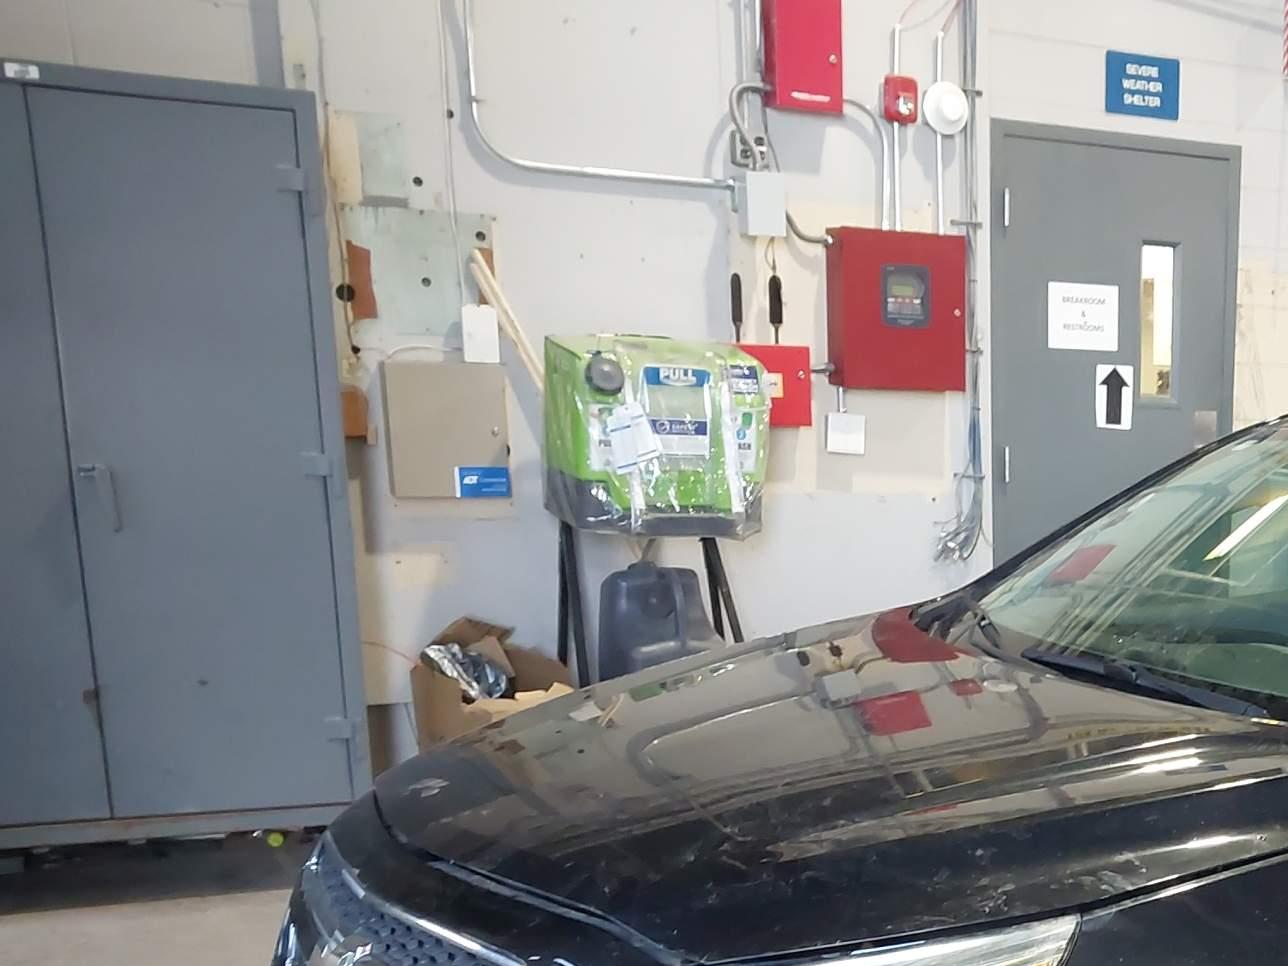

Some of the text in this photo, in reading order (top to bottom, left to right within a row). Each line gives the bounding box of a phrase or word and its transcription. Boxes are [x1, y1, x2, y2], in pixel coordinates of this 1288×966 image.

[1125, 63, 1159, 78] SEVERE
[1122, 78, 1163, 93] WEATHER
[1123, 93, 1161, 107] SHELTER
[1062, 295, 1106, 305] BREAKROOM
[659, 367, 697, 381] PULL
